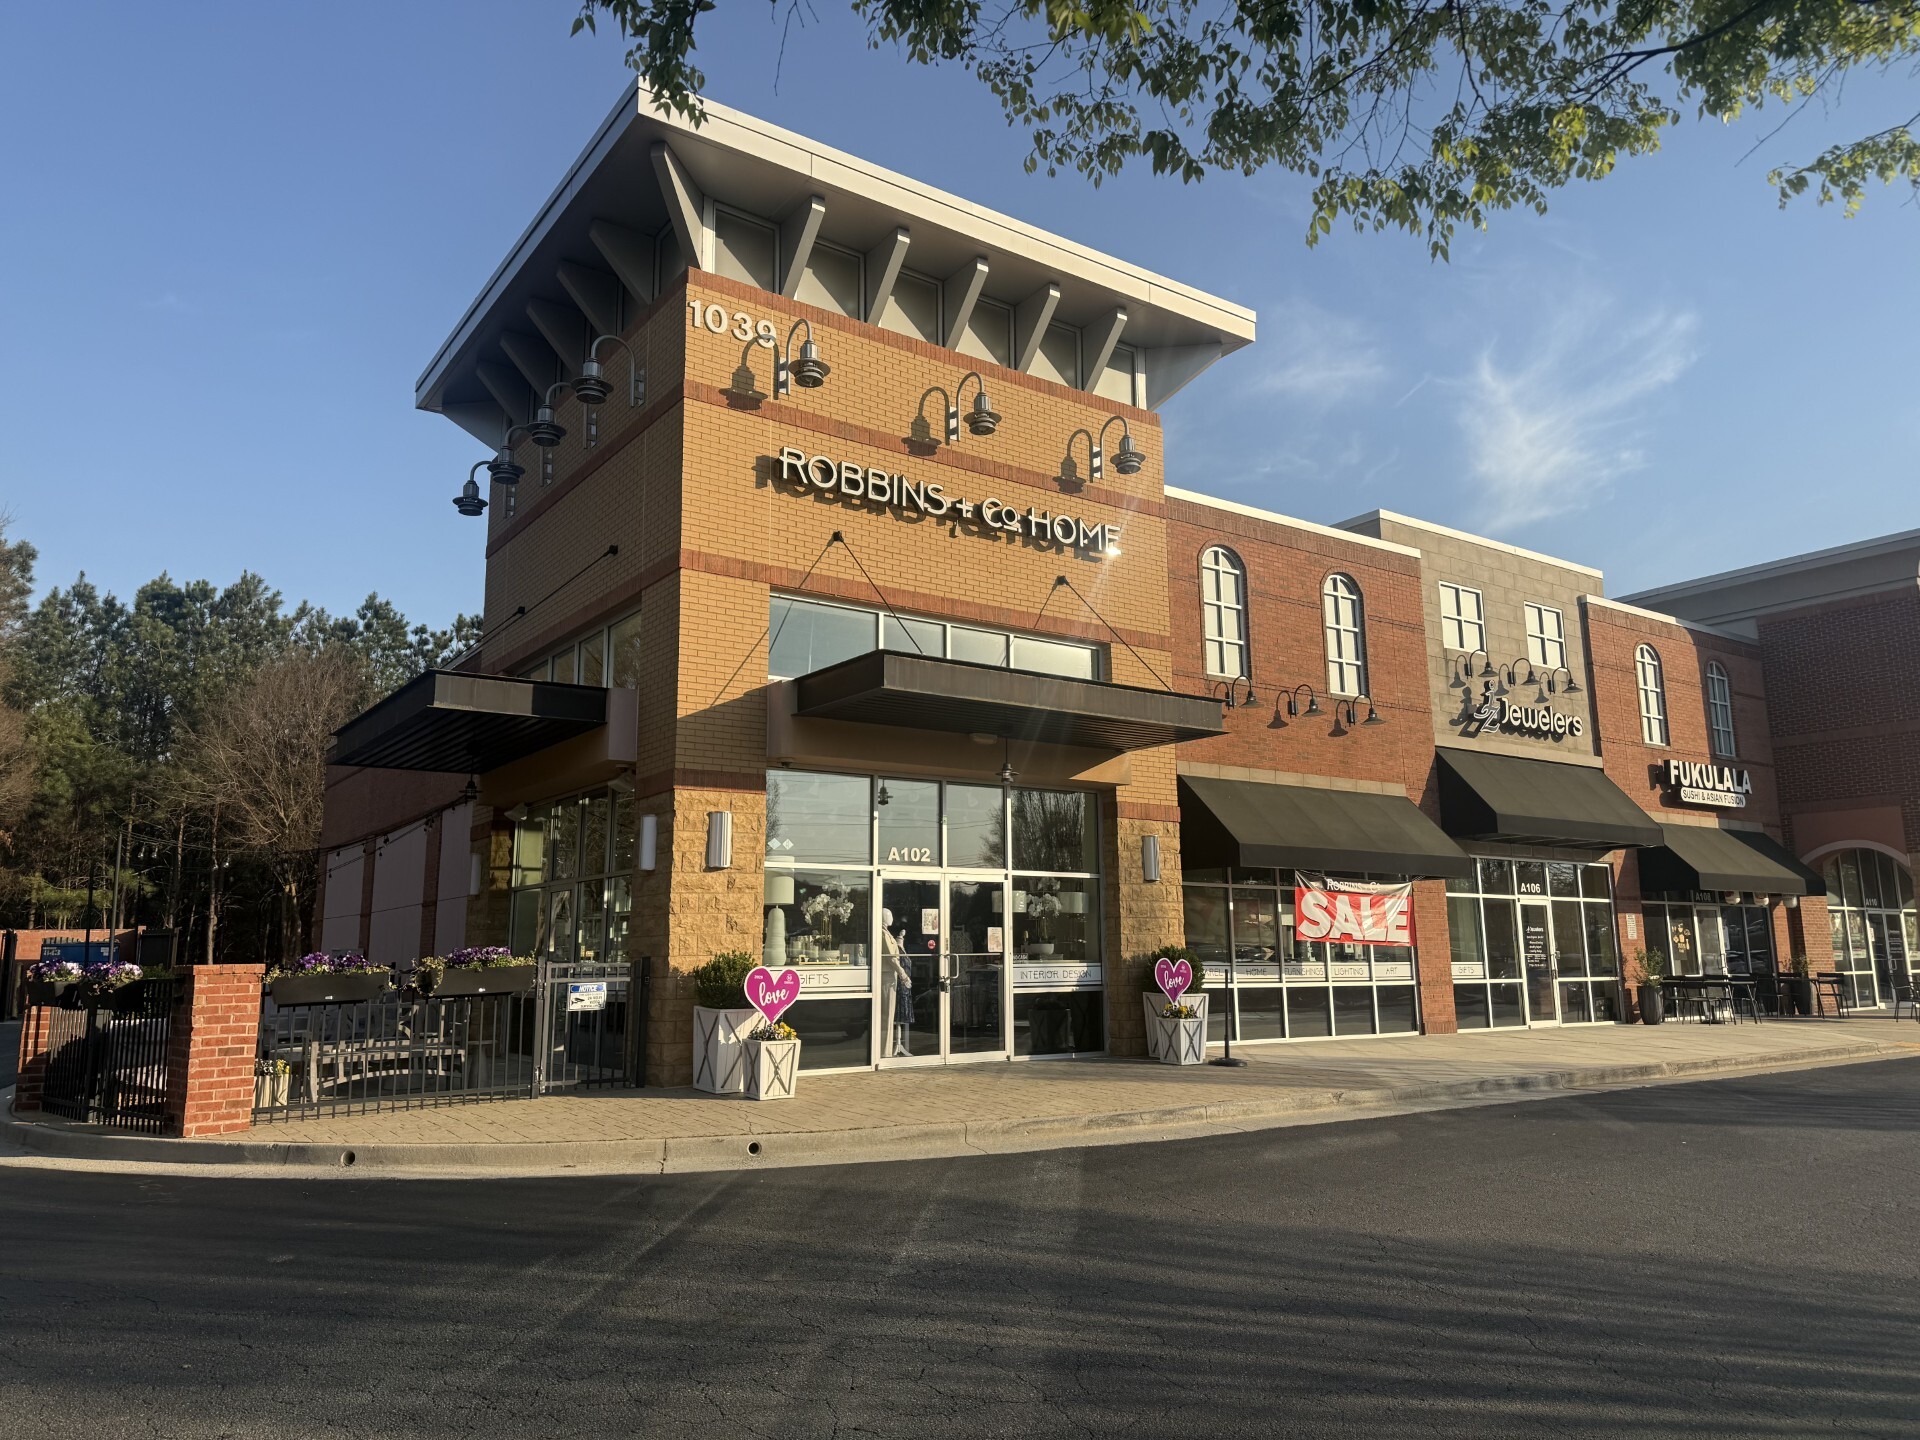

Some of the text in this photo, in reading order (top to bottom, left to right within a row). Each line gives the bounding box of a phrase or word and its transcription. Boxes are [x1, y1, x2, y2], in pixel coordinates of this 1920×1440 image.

[687, 299, 777, 348] 1039
[778, 446, 947, 515] ROBBINS
[1028, 507, 1122, 556] HOME
[1502, 697, 1583, 737] Jewelers
[1670, 760, 1752, 794] FUKULALA
[1682, 789, 1700, 800] SUSHI
[1706, 793, 1724, 803] ASIAN
[1724, 795, 1744, 806] FUSION
[887, 846, 931, 862] A102
[1520, 882, 1541, 893] A106
[1298, 890, 1410, 943] SALE
[1020, 968, 1092, 980] INTERIOR DESIGN
[1245, 967, 1268, 977] HOME
[1284, 967, 1324, 976] FURNISHINGS
[1333, 967, 1364, 976] LIGHTING
[1385, 966, 1398, 975] ART
[800, 973, 830, 985] GIFTS
[1163, 970, 1185, 990] love
[758, 981, 790, 1007] love
